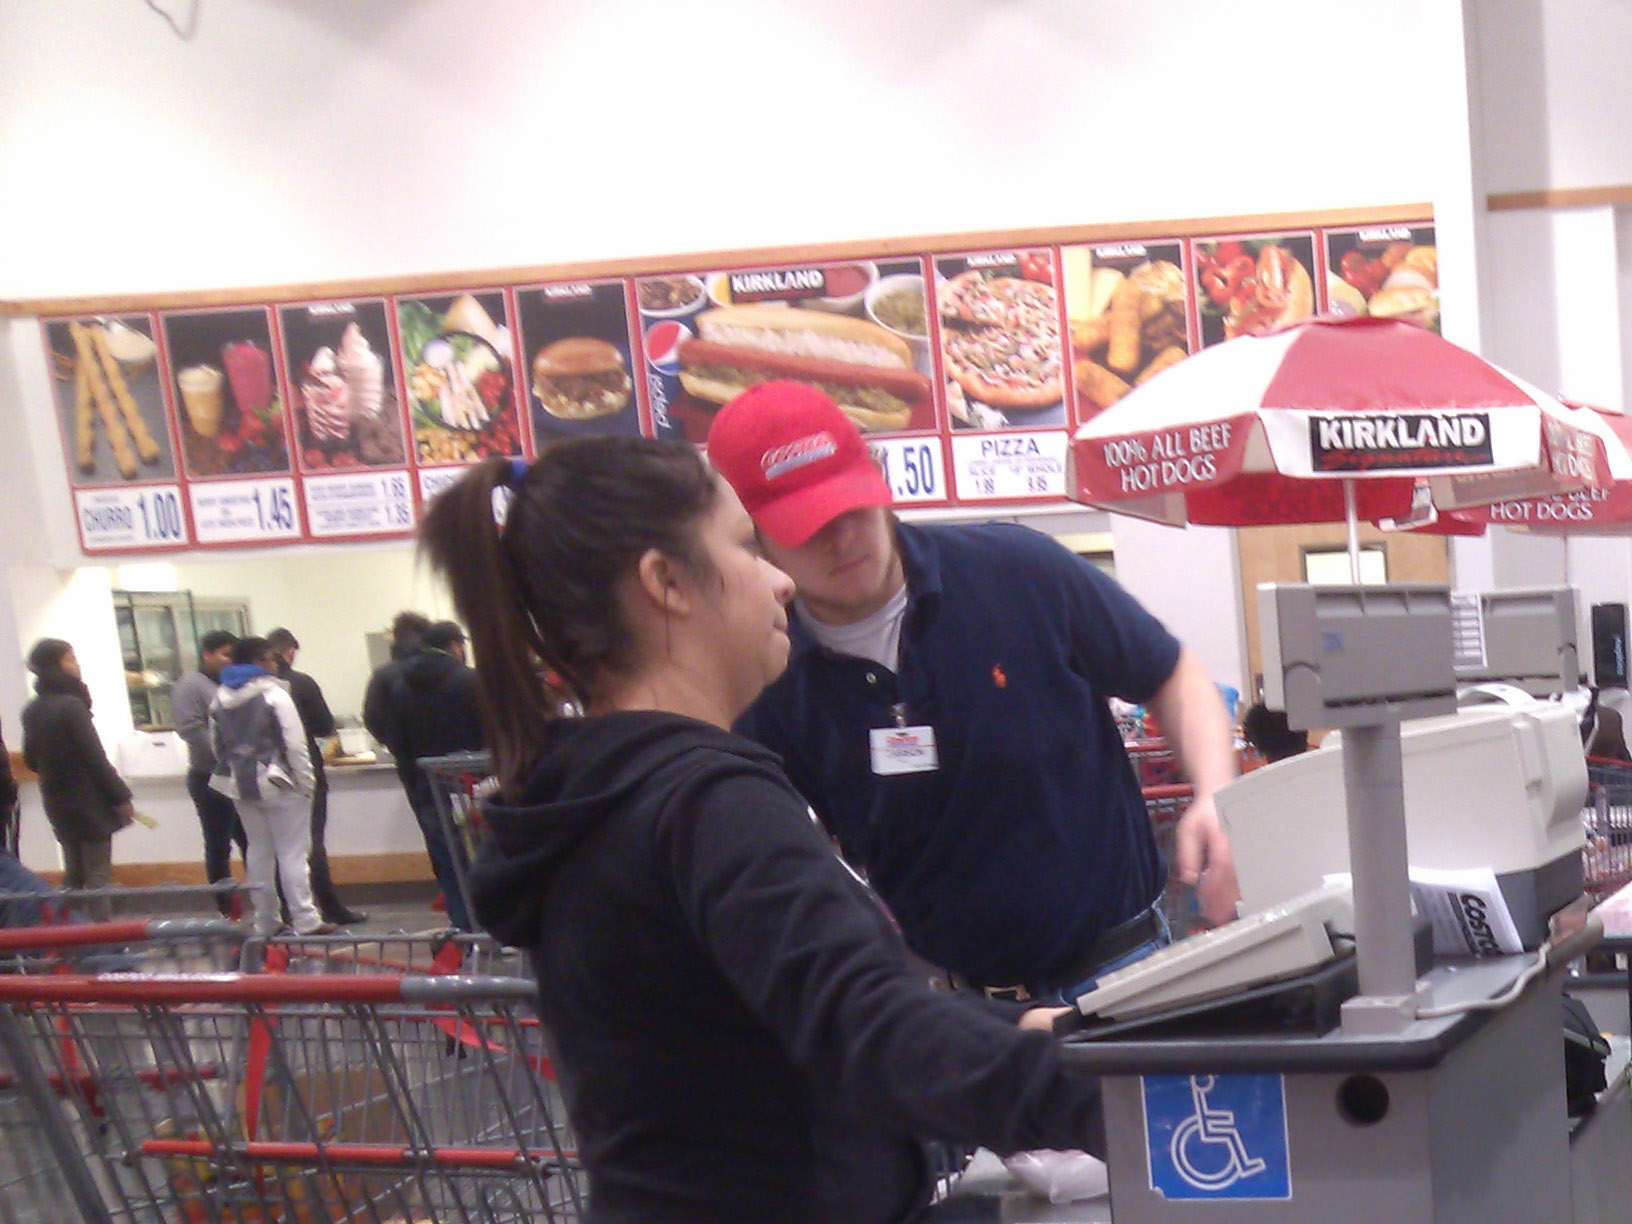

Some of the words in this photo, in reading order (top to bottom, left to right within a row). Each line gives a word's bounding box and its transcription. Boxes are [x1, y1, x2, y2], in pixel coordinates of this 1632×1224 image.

[731, 269, 825, 294] KIRKLAND
[980, 437, 1041, 457] PIZZA
[1103, 440, 1147, 468] 100%
[1151, 433, 1187, 461] ALL
[1189, 422, 1232, 453] BEEF
[1318, 416, 1487, 450] KIRKLAND
[1120, 464, 1160, 493] HOT
[1161, 454, 1218, 484] DOGS
[84, 506, 133, 532] CHURRO
[137, 492, 181, 540] 1.00
[253, 487, 293, 532] 1.45
[1490, 501, 1532, 521] HOT
[1536, 501, 1594, 521] DOGS
